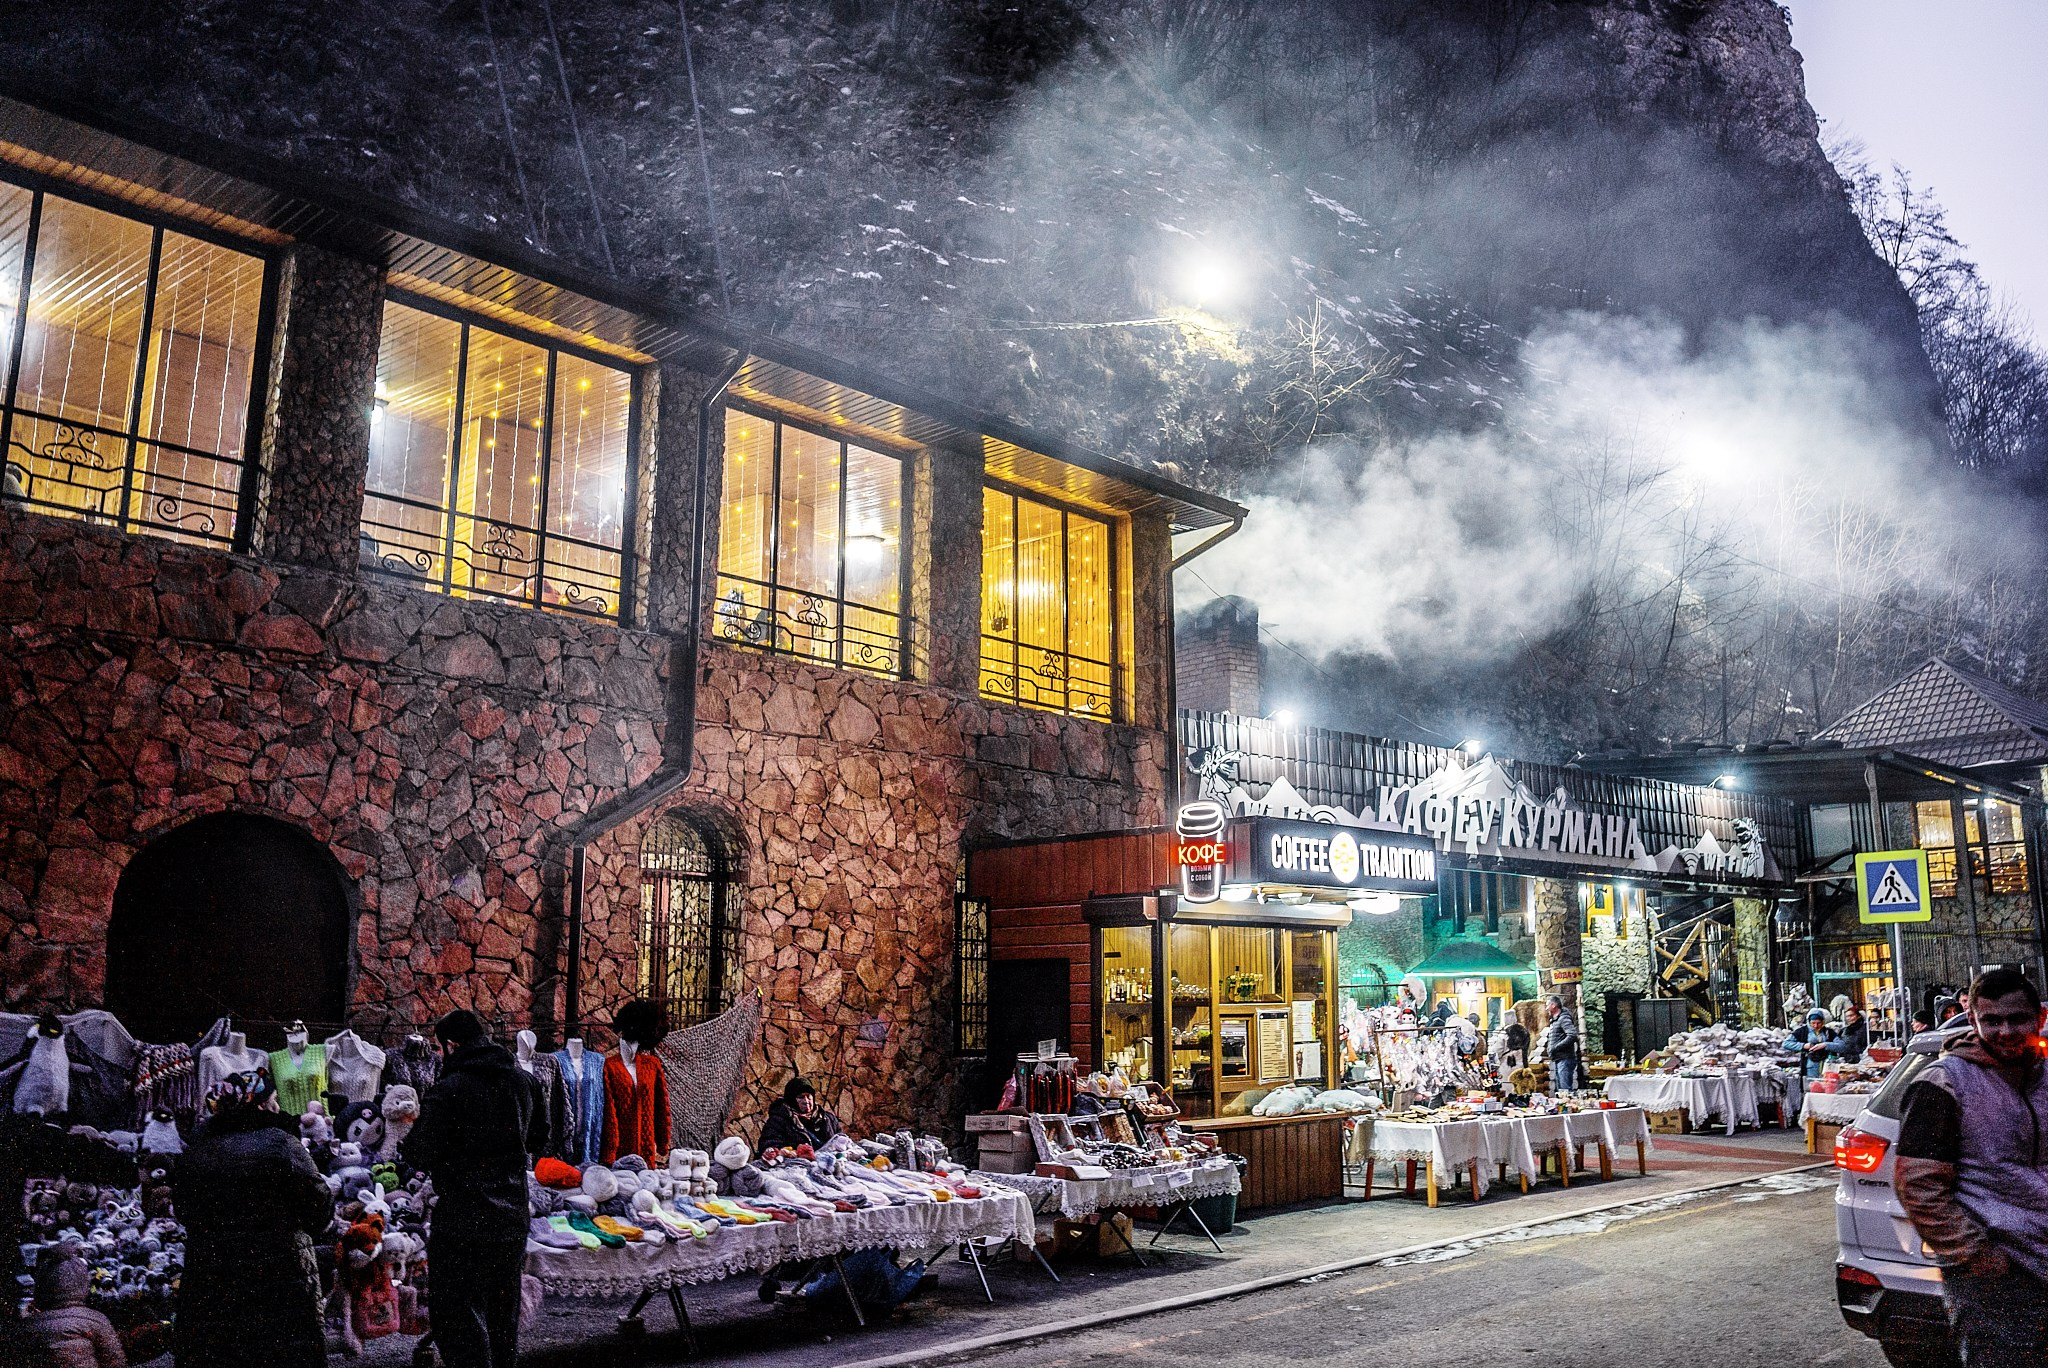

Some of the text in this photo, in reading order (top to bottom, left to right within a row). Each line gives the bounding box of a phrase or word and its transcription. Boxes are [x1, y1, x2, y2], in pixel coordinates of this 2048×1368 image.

[1379, 785, 1470, 842] КАФЕ
[1502, 797, 1639, 859] КУРМАНА
[1178, 843, 1225, 864] КОФЕ
[1271, 833, 1435, 882] COFFEE TRADITION
[1190, 864, 1212, 873] ВОЗЬМИ
[1190, 872, 1212, 882] С СОБОЙ
